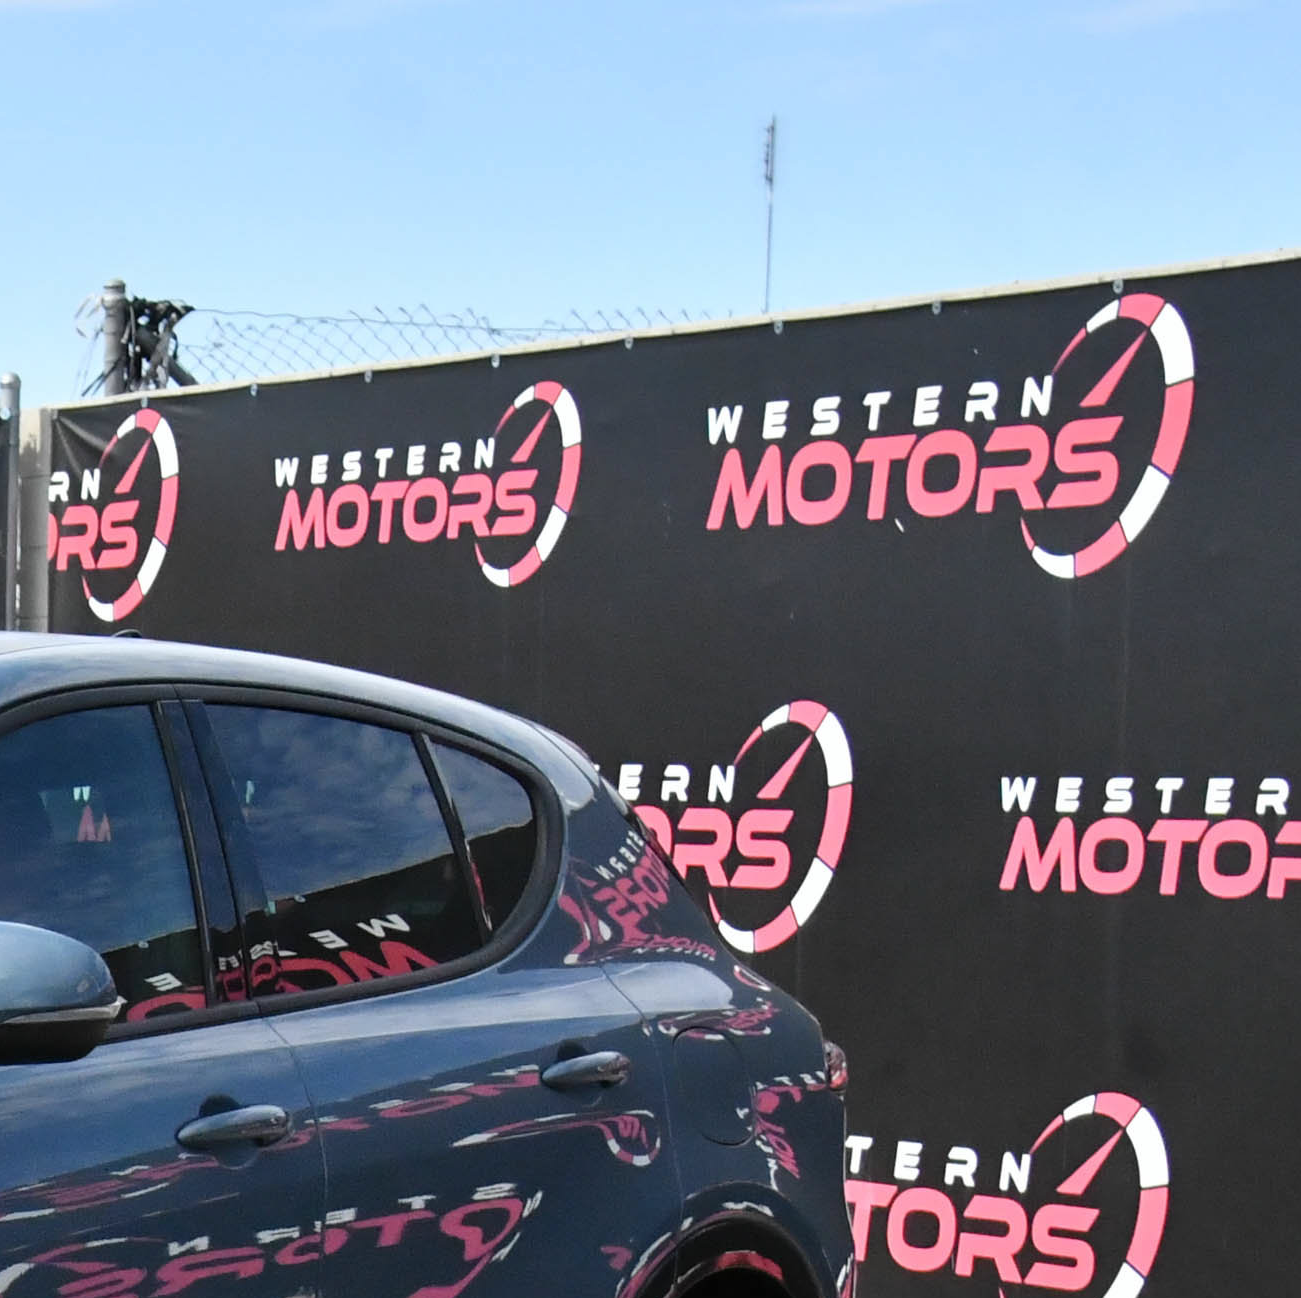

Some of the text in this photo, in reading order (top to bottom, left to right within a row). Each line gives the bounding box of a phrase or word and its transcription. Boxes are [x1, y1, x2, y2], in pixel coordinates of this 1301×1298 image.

[708, 375, 1053, 445] WESTERN
[275, 437, 495, 487] WESTERN
[707, 416, 1123, 530] MOTORS
[275, 469, 539, 551] MOTORS
[1001, 776, 1289, 816] WESTER
[845, 1135, 1031, 1194] TERN
[844, 1179, 1100, 1292] TORS
